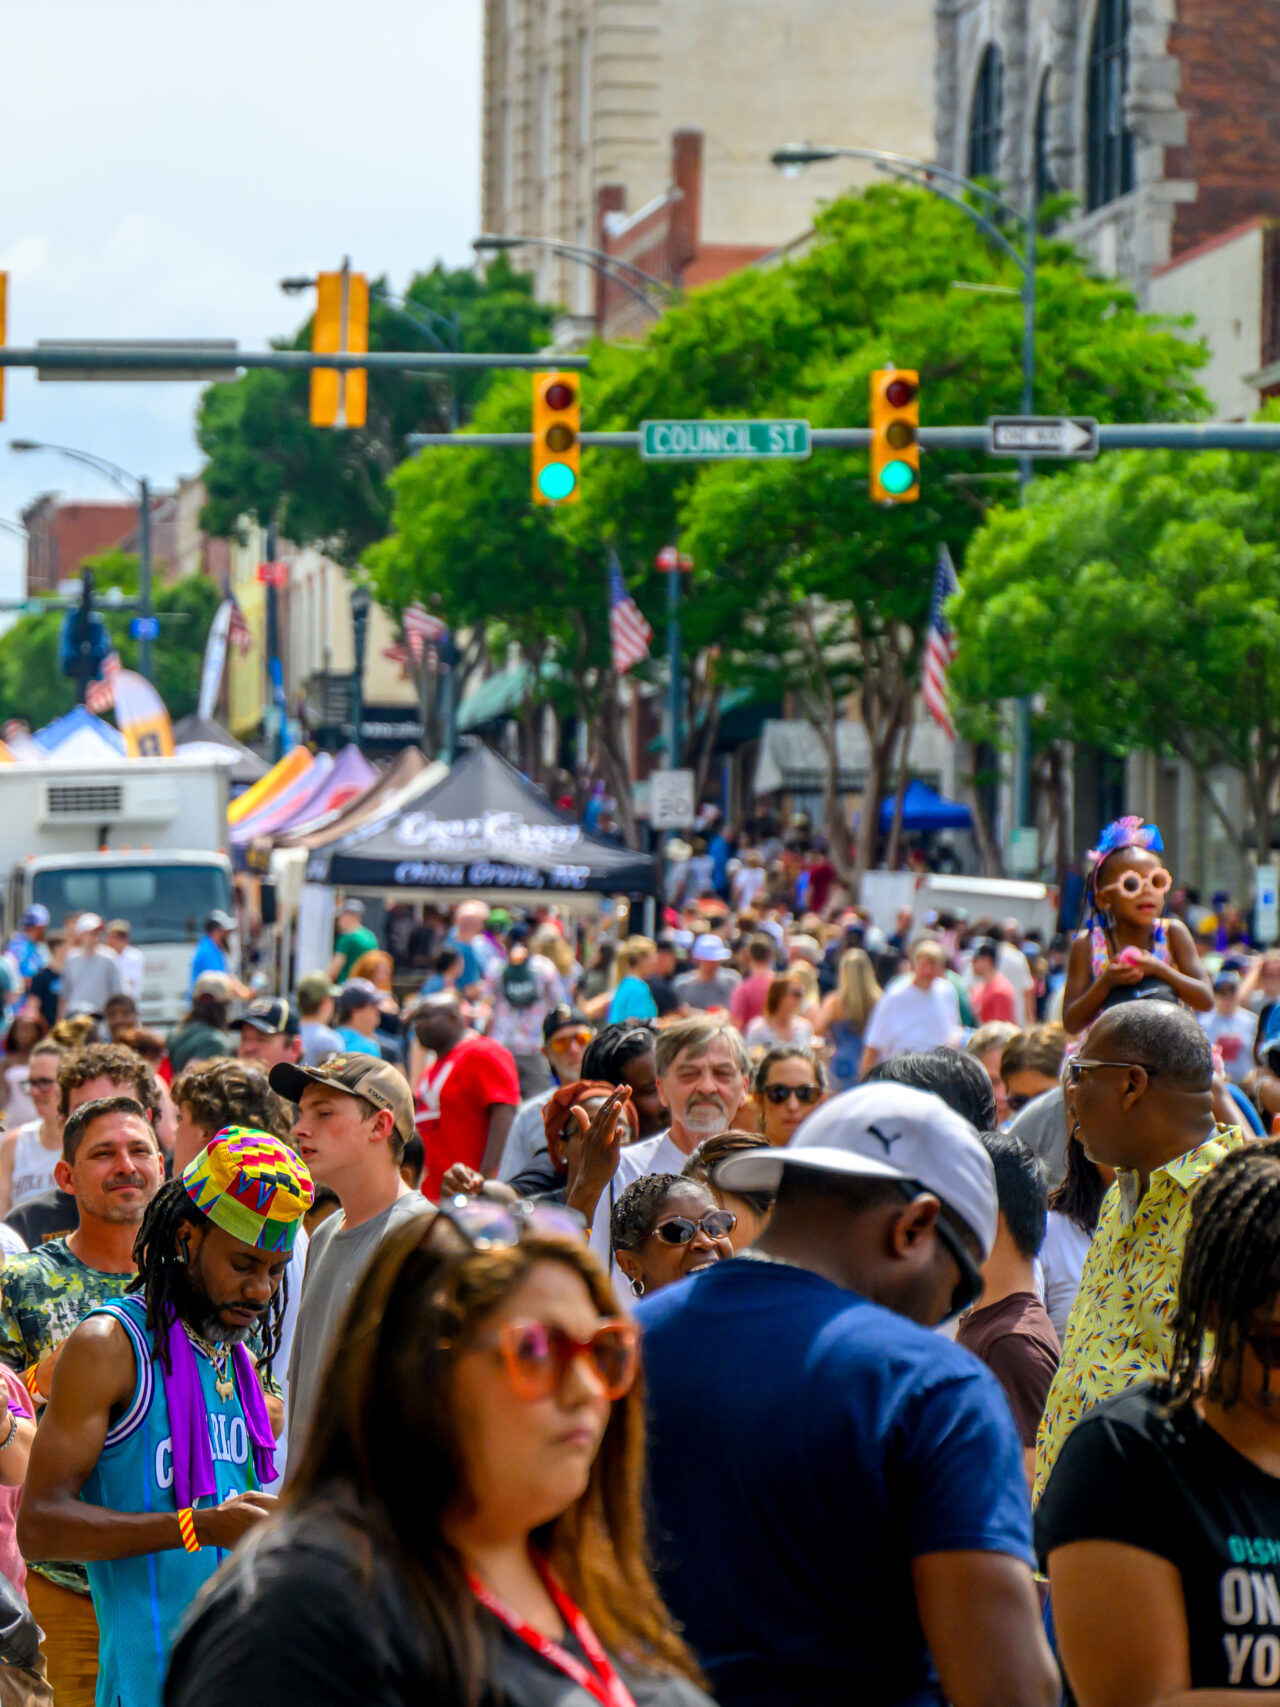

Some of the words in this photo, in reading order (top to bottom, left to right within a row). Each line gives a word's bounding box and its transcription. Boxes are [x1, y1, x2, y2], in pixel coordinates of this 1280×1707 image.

[653, 424, 758, 451] COUNCIL
[768, 424, 799, 451] ST
[1000, 427, 1027, 442] ONE
[1036, 427, 1063, 442] WAY
[368, 1087, 385, 1102] STAFF
